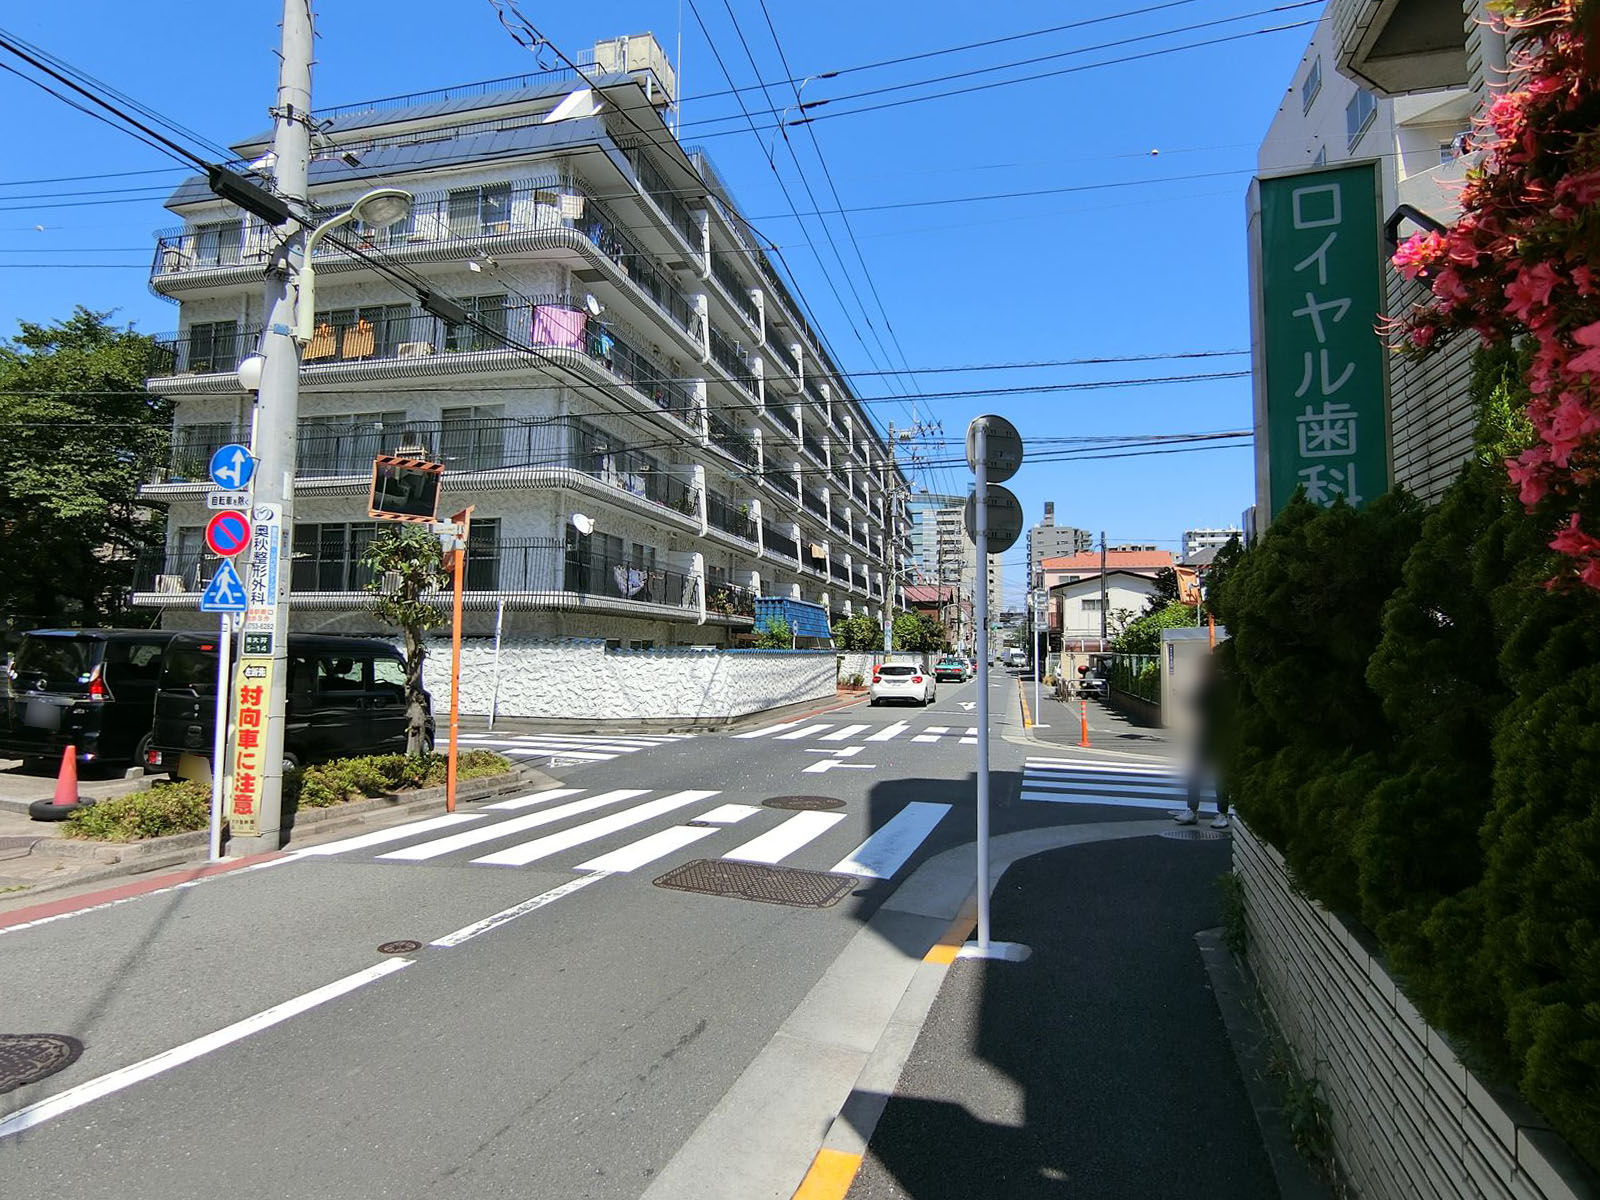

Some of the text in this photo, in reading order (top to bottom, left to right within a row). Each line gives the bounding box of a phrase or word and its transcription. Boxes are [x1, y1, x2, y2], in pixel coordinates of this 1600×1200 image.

[211, 495, 249, 506] 自転車を除く
[251, 525, 269, 605] 奥秋整形外科
[233, 685, 264, 815] 対向車に注意
